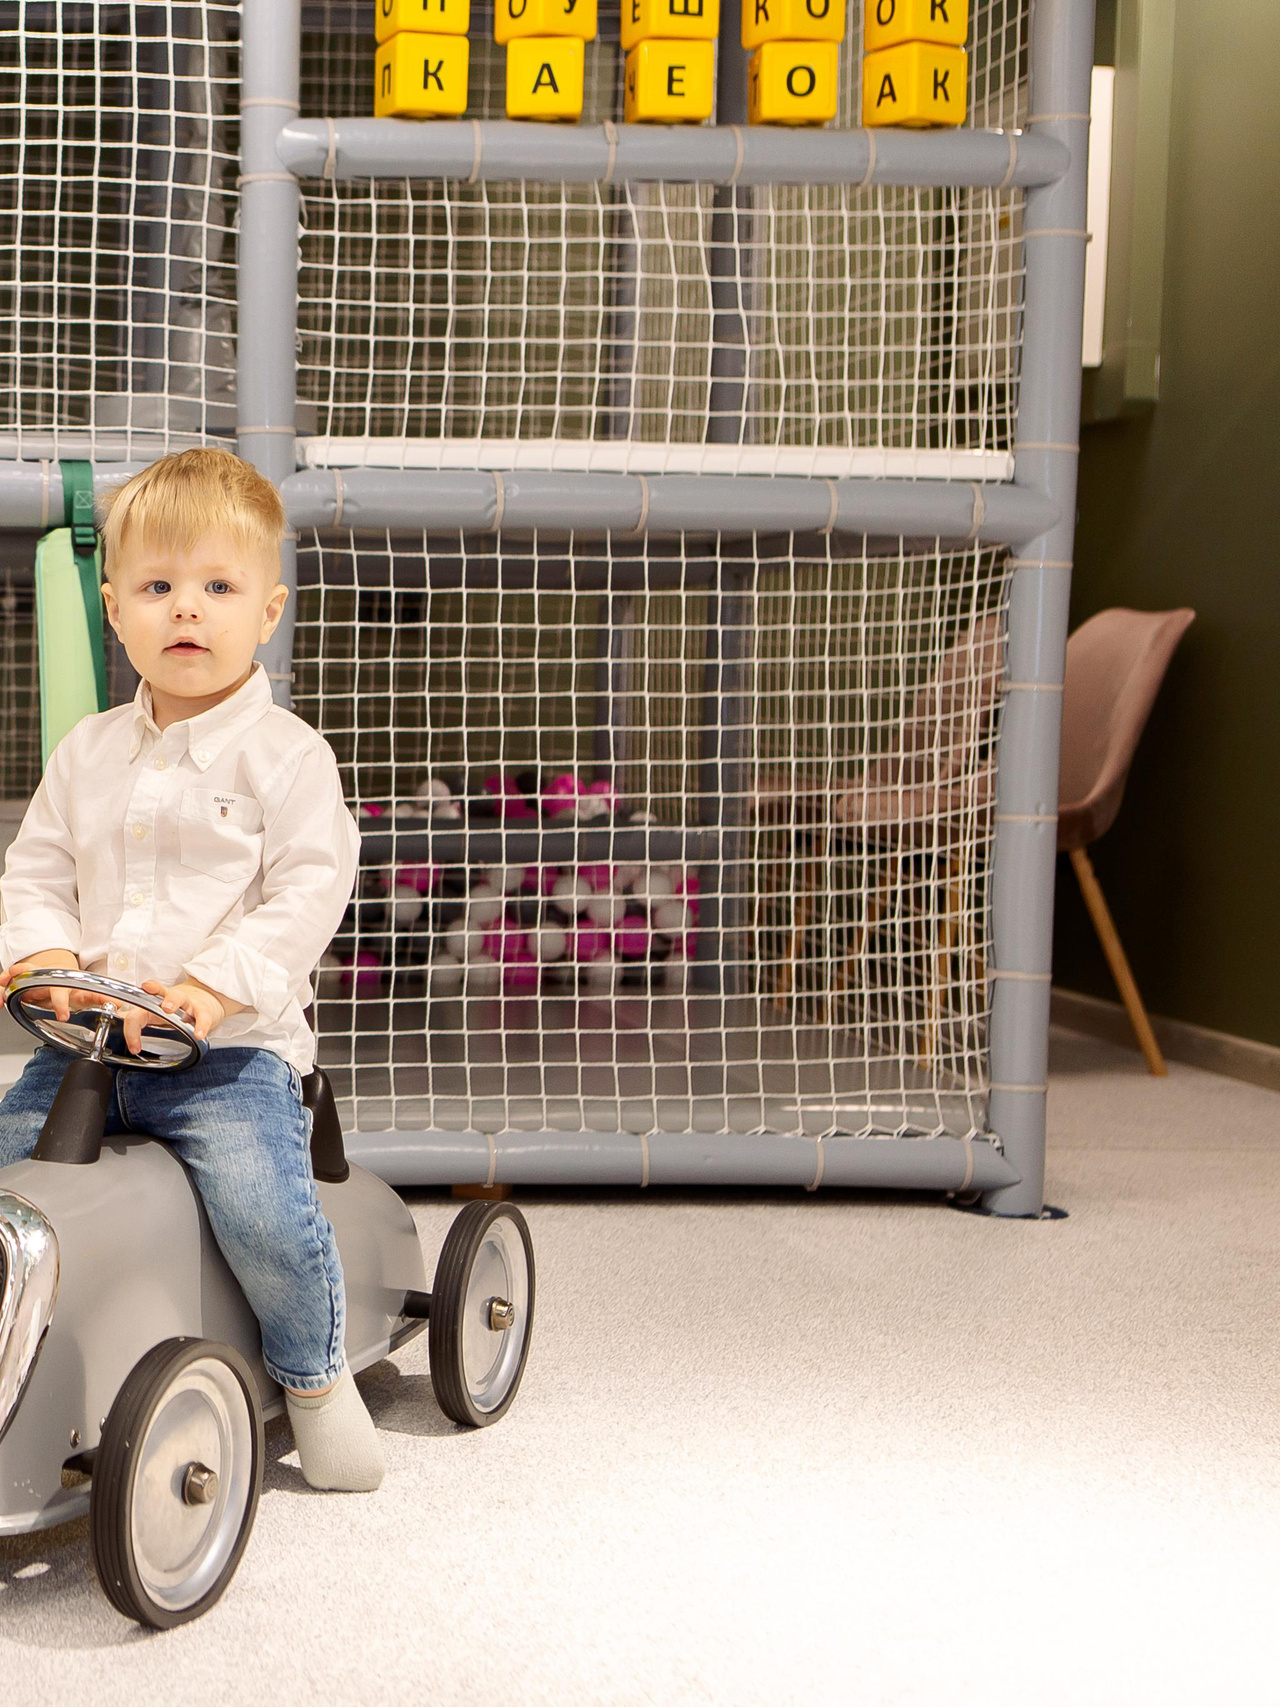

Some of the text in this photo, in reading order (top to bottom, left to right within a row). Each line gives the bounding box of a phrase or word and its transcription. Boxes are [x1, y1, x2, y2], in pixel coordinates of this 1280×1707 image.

[423, 59, 444, 91] К
[532, 63, 559, 94] А
[667, 66, 686, 96] Е
[786, 66, 816, 97] О
[876, 73, 897, 108] А
[933, 67, 950, 102] К
[214, 796, 236, 805] GANT
